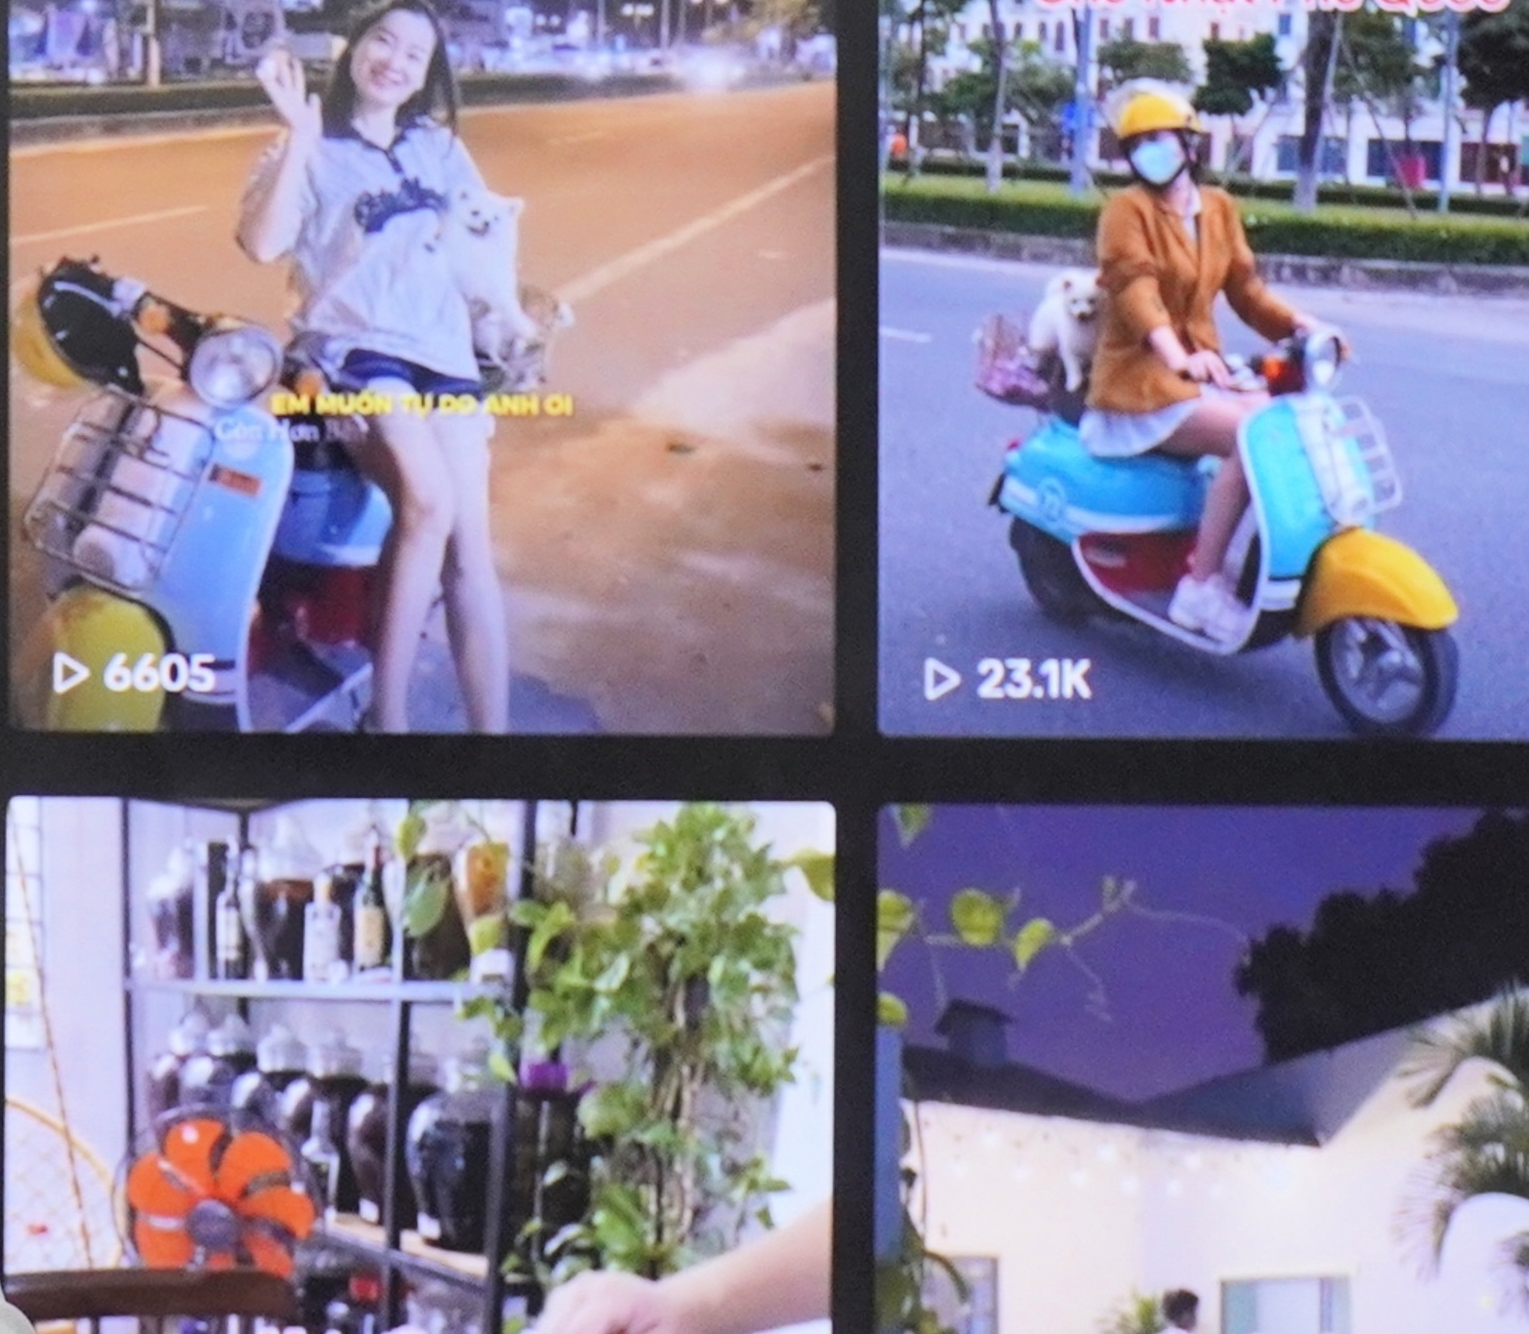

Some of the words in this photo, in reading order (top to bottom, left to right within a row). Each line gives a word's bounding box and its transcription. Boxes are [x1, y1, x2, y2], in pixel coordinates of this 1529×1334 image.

[270, 393, 310, 416] EM
[482, 393, 539, 416] ANH
[102, 651, 217, 693] 6605
[975, 658, 1092, 701] 23.1K
